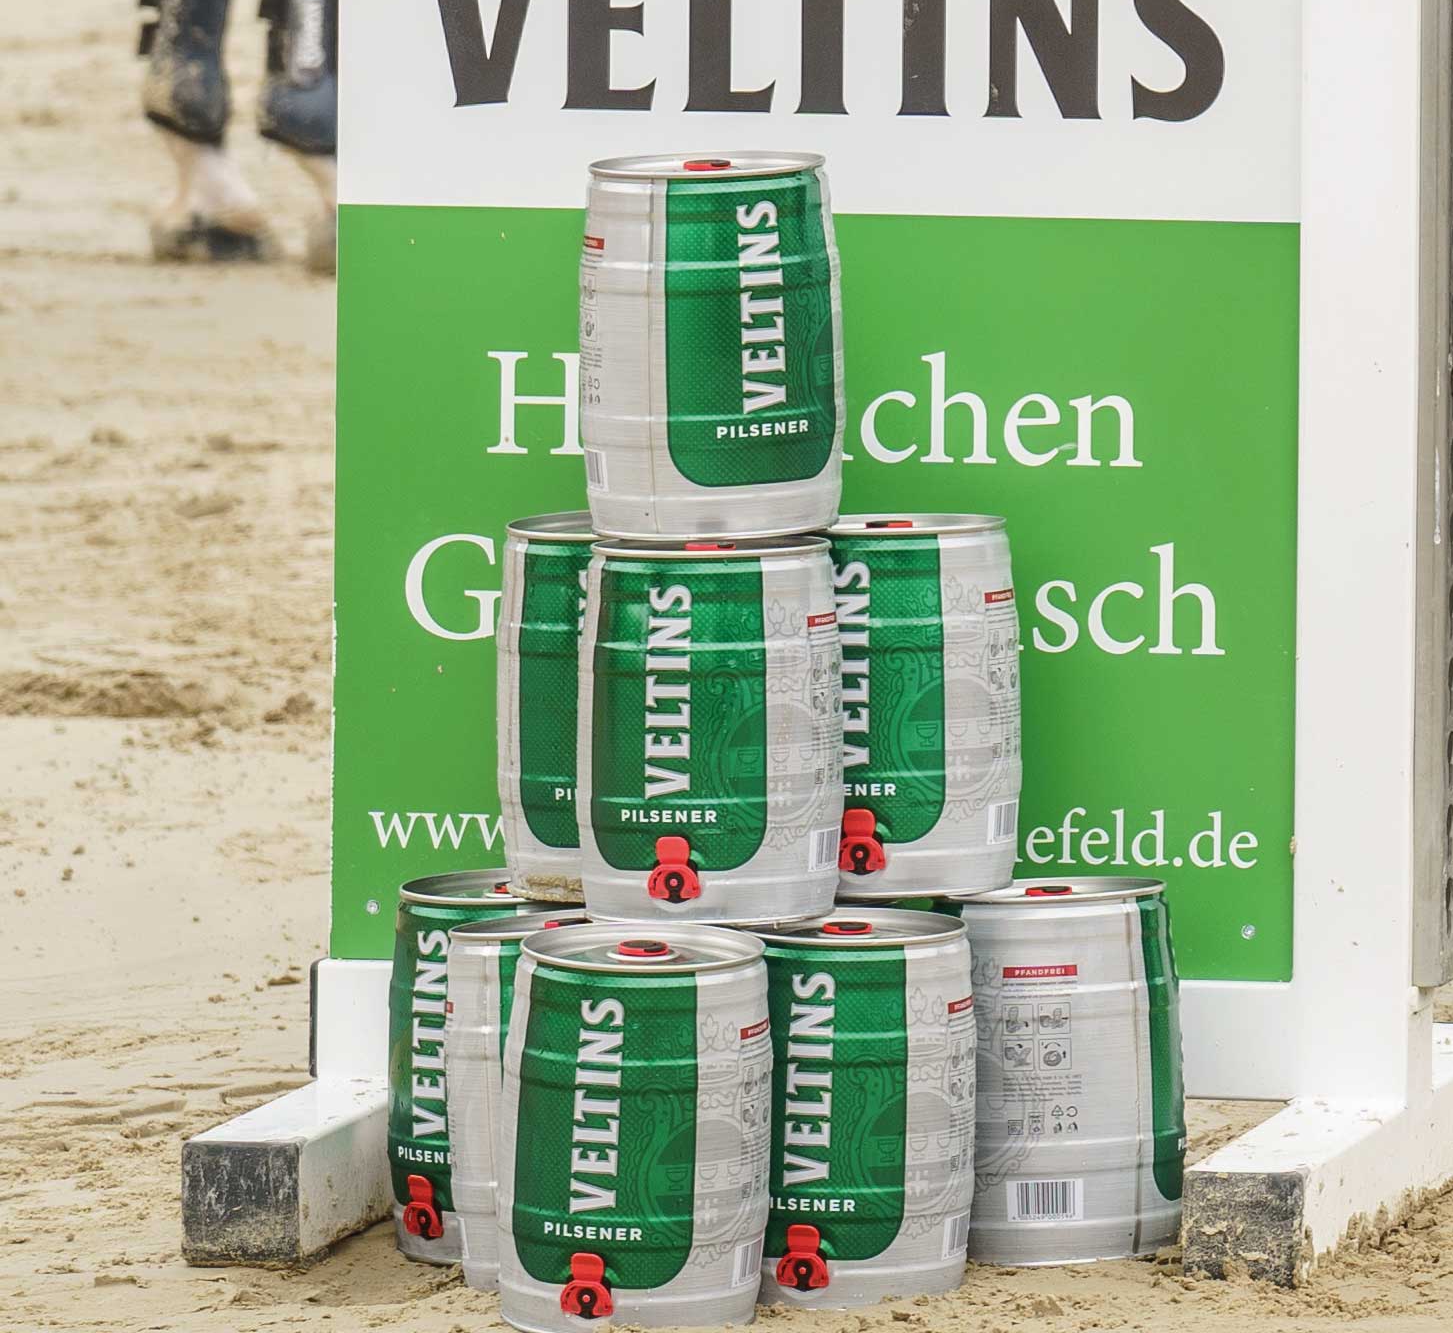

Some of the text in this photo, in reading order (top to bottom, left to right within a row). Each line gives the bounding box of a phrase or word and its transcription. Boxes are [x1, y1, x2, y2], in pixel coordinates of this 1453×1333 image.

[736, 199, 787, 415] VELTINS
[716, 419, 810, 440] PILSENER
[644, 583, 693, 800] VELTINS
[843, 783, 898, 798] ENER
[620, 808, 719, 824] PILSENER
[1014, 967, 1066, 978] PFANDFREI
[412, 929, 451, 1139] VELTINS
[782, 970, 837, 1188] VELTINS
[568, 996, 626, 1215] VELTINS
[398, 1145, 453, 1165] PILSENE
[770, 1196, 857, 1213] ILSENER
[543, 1220, 644, 1242] PILSENER
